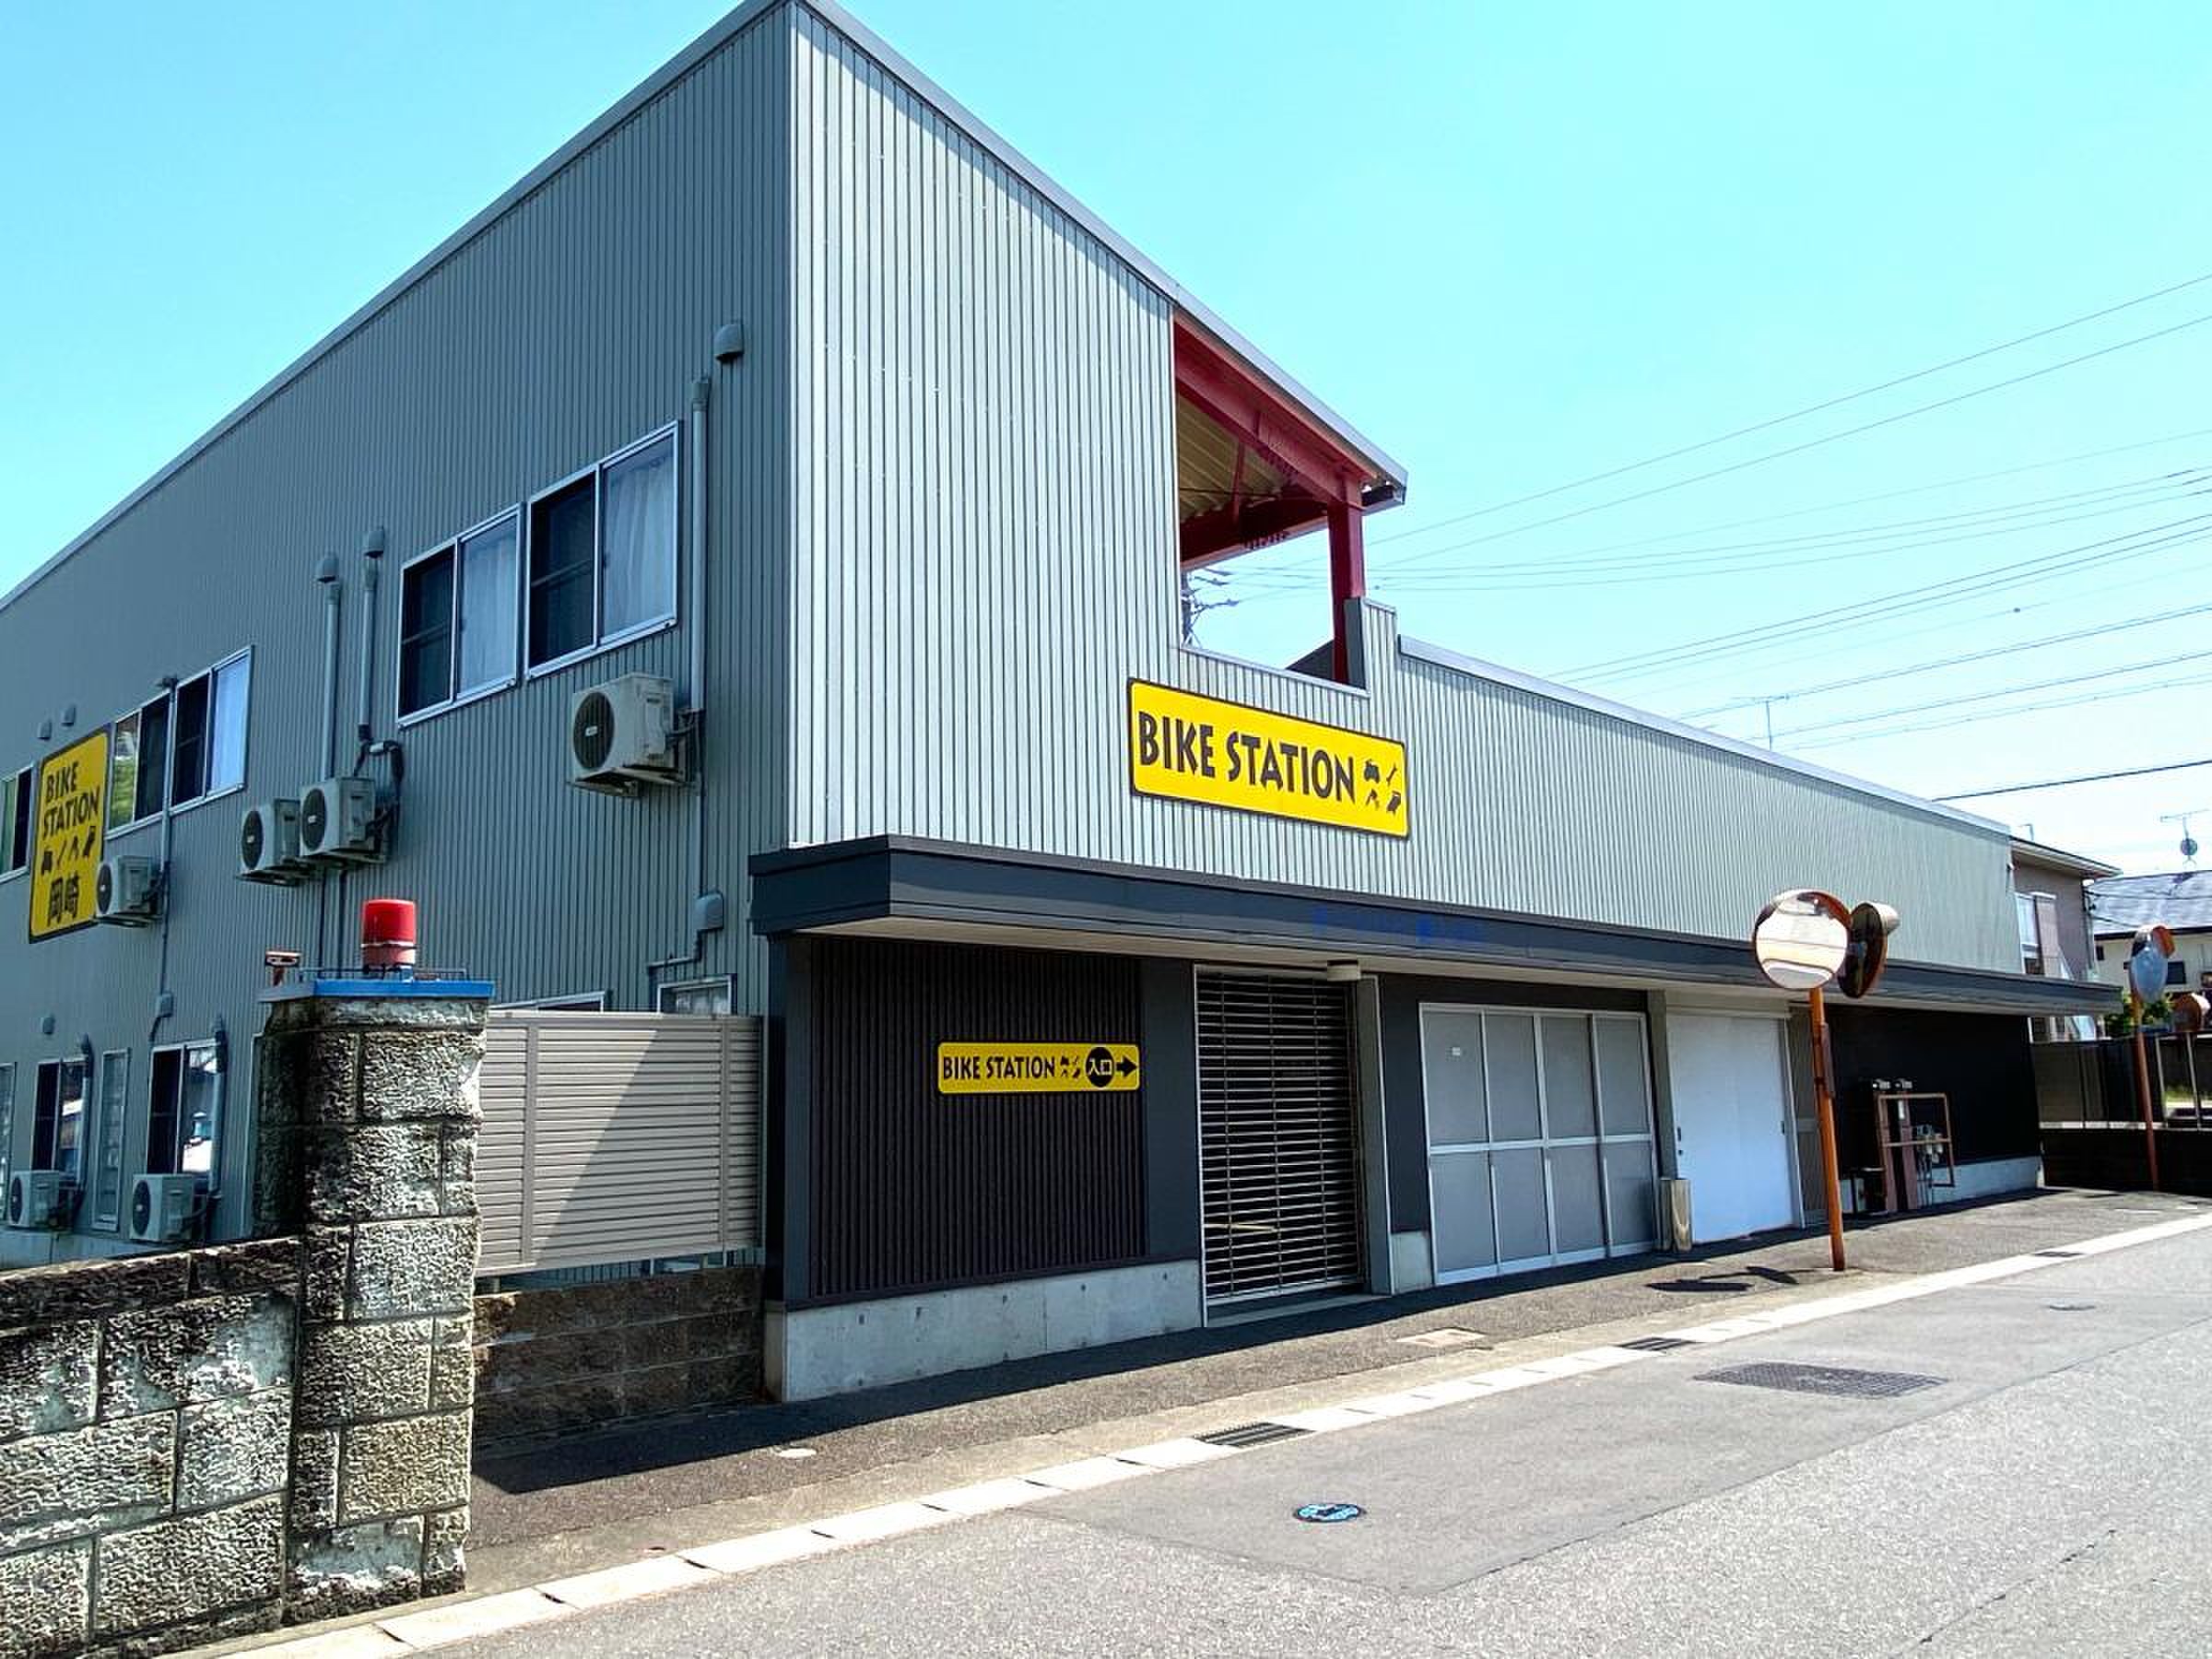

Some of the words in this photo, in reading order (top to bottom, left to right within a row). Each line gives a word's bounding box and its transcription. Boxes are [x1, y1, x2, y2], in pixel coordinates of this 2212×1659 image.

[1138, 711, 1215, 778] BIKE
[1227, 731, 1355, 804] STATION
[47, 761, 78, 800] BIKE
[43, 786, 100, 837] STATION
[943, 1056, 981, 1079] BIKE
[985, 1056, 1055, 1079] STATION
[1088, 1058, 1112, 1076] 入口
